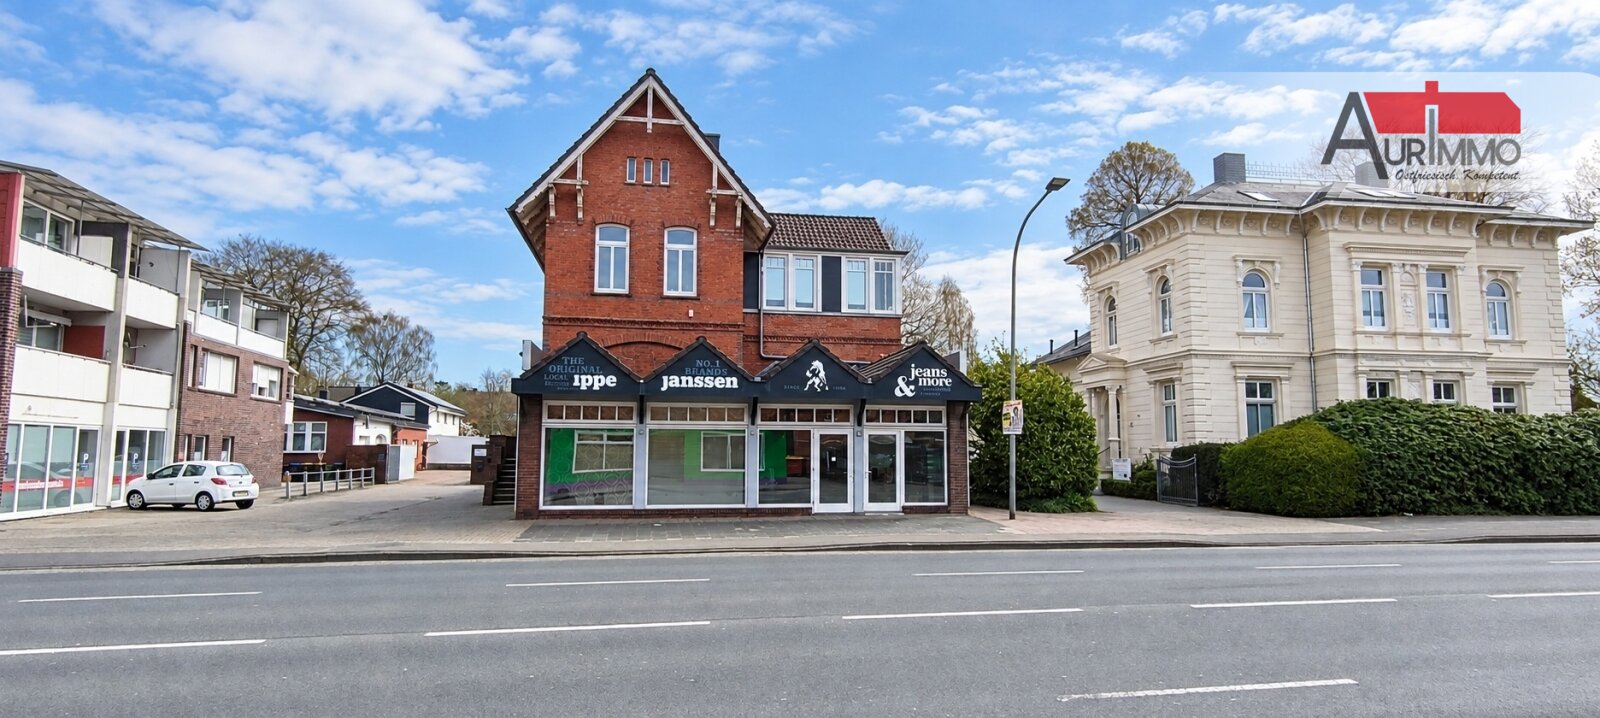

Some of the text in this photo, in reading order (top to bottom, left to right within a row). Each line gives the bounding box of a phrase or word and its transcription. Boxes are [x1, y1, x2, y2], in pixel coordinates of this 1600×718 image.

[561, 356, 585, 365] THE
[548, 364, 603, 374] ORIGINAL
[685, 367, 728, 376] BRANDS
[909, 363, 948, 381] jeans
[544, 373, 569, 381] LOCAL
[660, 374, 739, 391] janssen
[894, 375, 952, 397] & more
